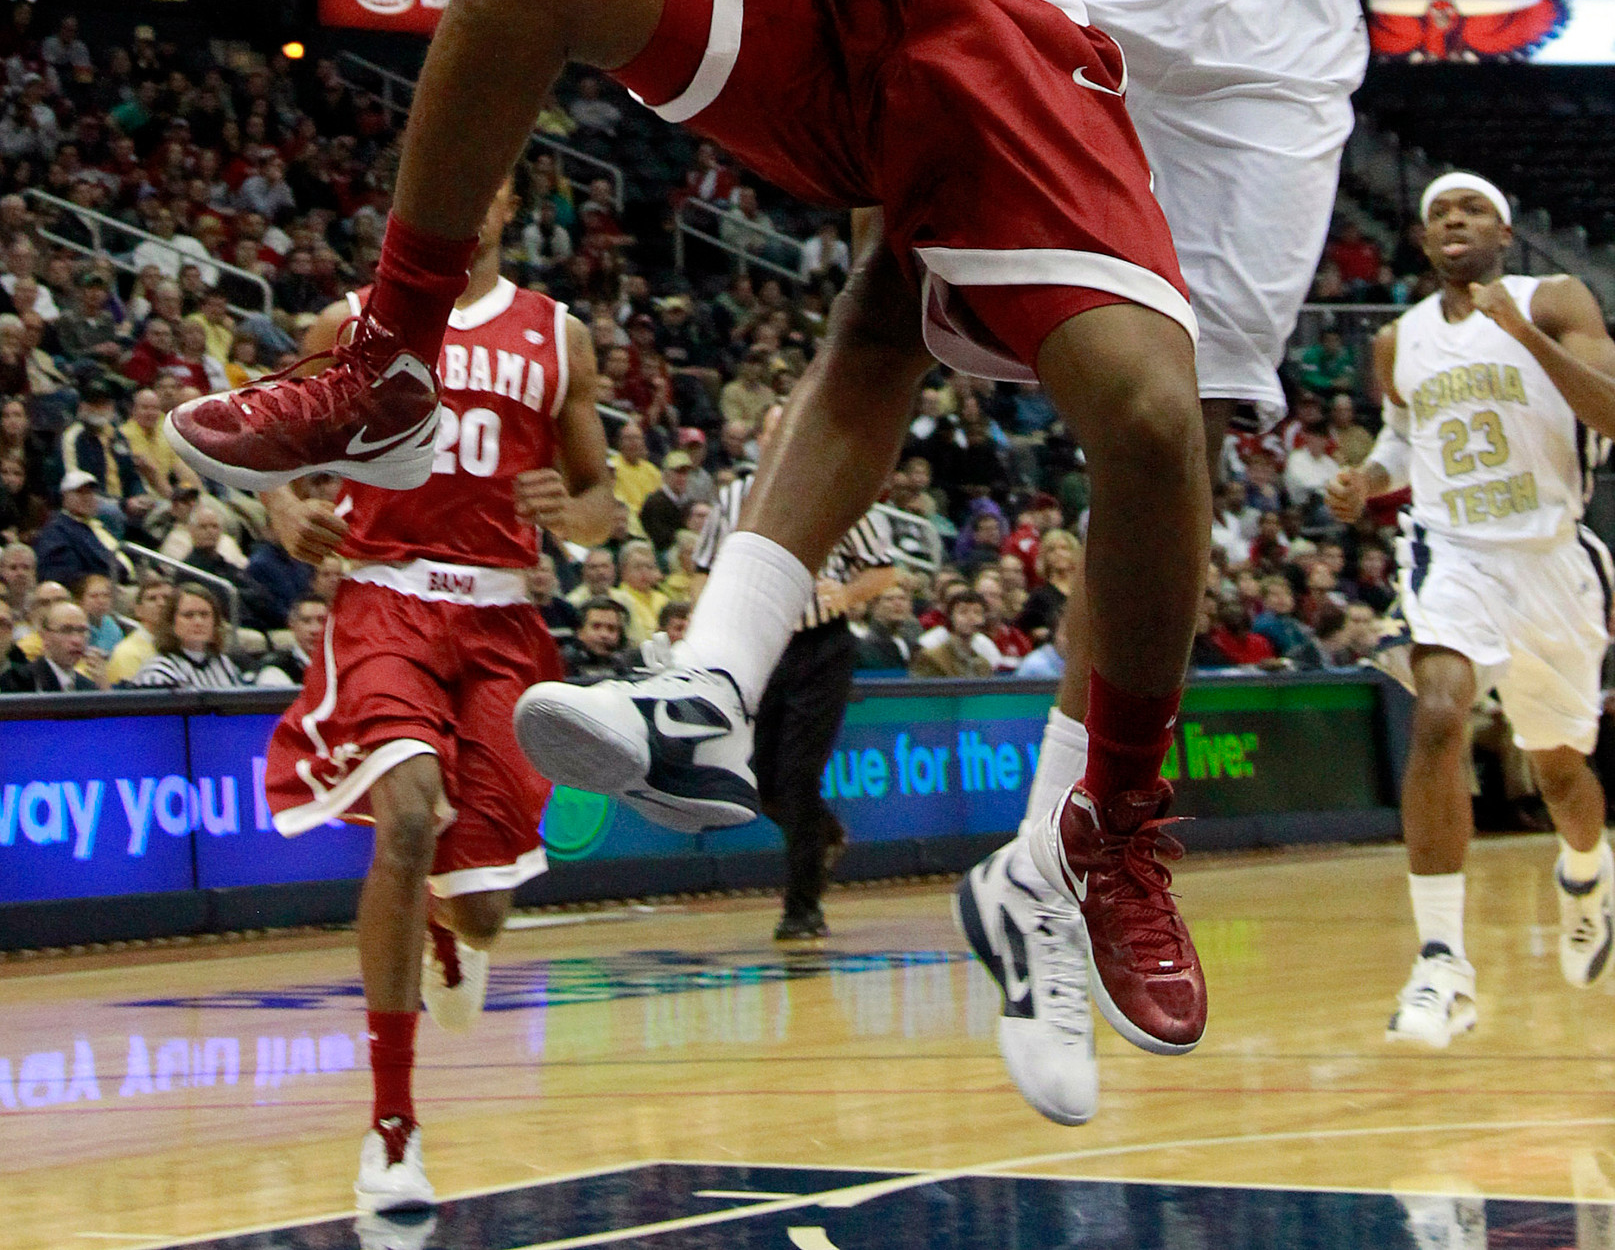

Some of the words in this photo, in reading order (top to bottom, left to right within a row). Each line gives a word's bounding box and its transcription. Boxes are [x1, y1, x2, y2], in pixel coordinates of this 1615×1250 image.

[1412, 363, 1528, 430] GEORGIA
[1438, 410, 1510, 477] 23
[1441, 471, 1539, 527] TECH
[894, 732, 950, 796] for
[958, 729, 1023, 792] the
[115, 774, 240, 858] you
